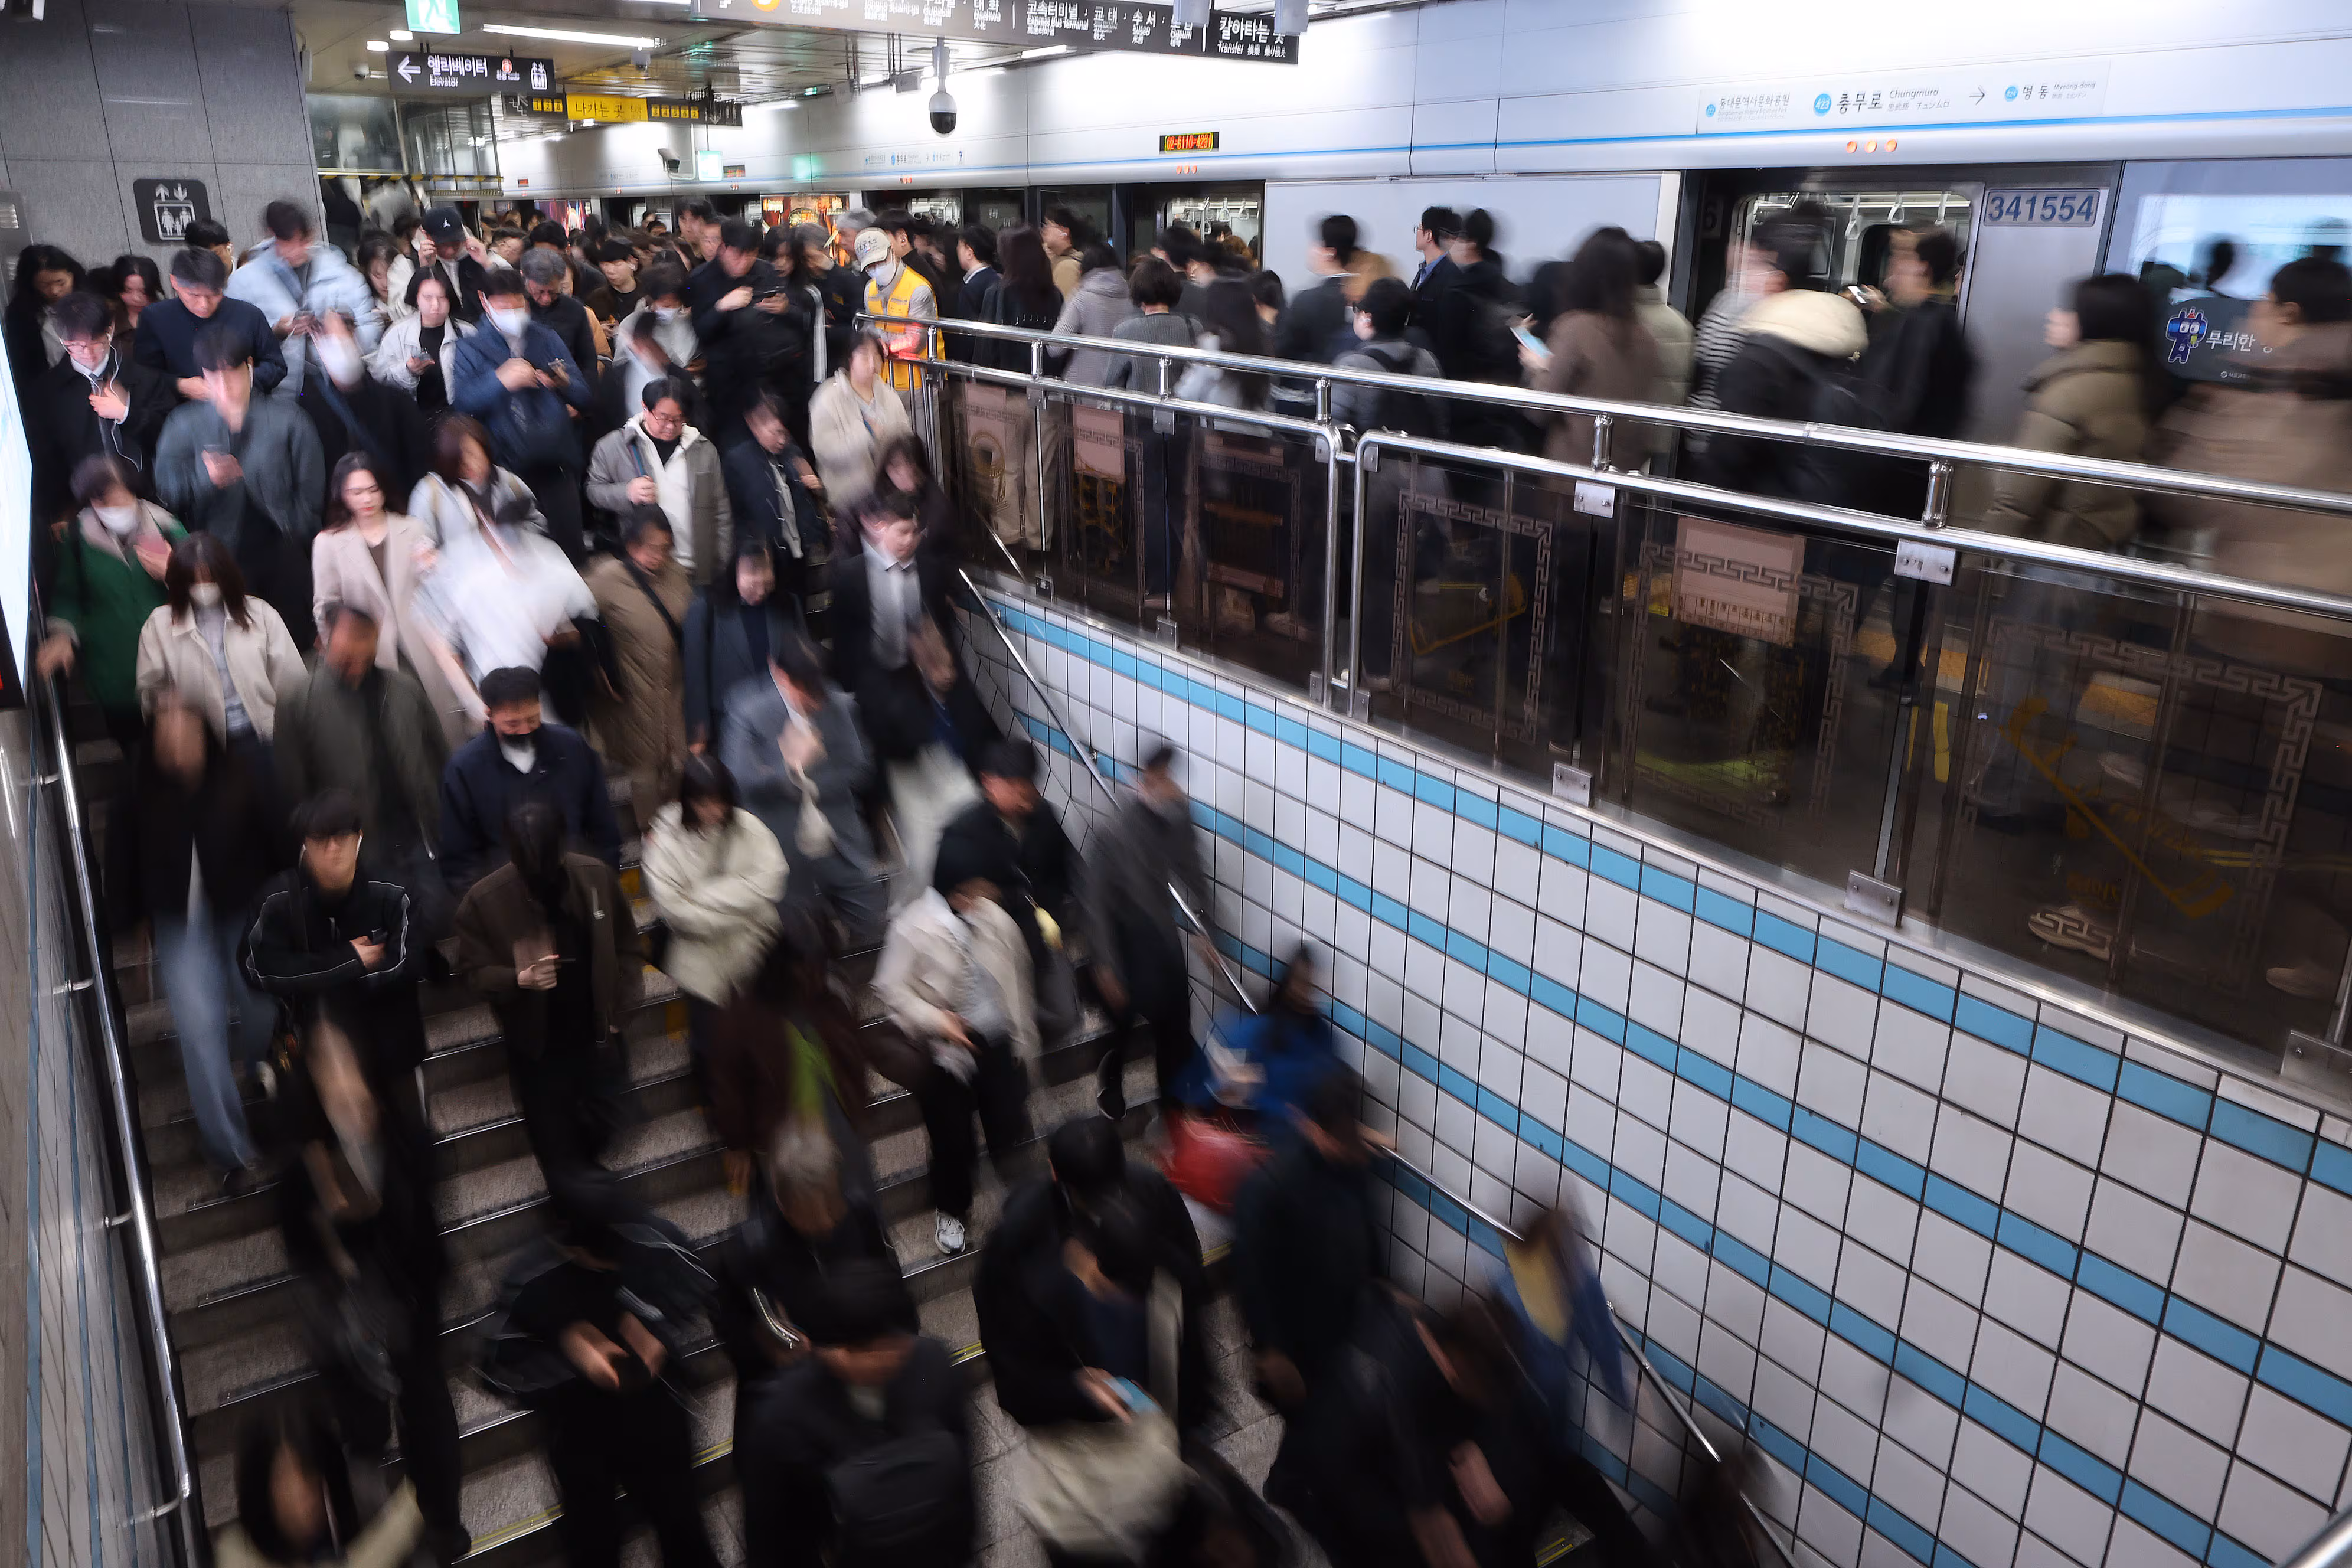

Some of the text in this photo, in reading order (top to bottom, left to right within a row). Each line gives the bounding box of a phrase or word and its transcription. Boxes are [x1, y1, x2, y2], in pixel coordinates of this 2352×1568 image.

[974, 9, 1001, 22] Daehwa
[1027, 0, 1078, 19] 고속터미널
[1027, 15, 1050, 27] Express
[1051, 17, 1062, 28] Bus
[1063, 18, 1089, 30] Terminal
[1132, 9, 1156, 28] 수서
[1132, 24, 1151, 36] Suseo
[1170, 28, 1193, 40] Ogeum
[1219, 17, 1270, 43] 갈아타는
[1217, 40, 1243, 54] Transfer
[427, 54, 488, 77] 엘리베이터
[429, 74, 459, 88] Elevator
[1889, 87, 1939, 100] Chungmuro
[2023, 85, 2049, 100] 명동
[576, 99, 610, 117] 나가는
[613, 105, 625, 117] 곳
[1719, 92, 1790, 110] 동대문역사문화공원
[1815, 99, 1830, 110] 423
[1837, 92, 1883, 115] 충무로
[1988, 194, 2094, 222] 341554
[2206, 330, 2256, 352] 무리한
